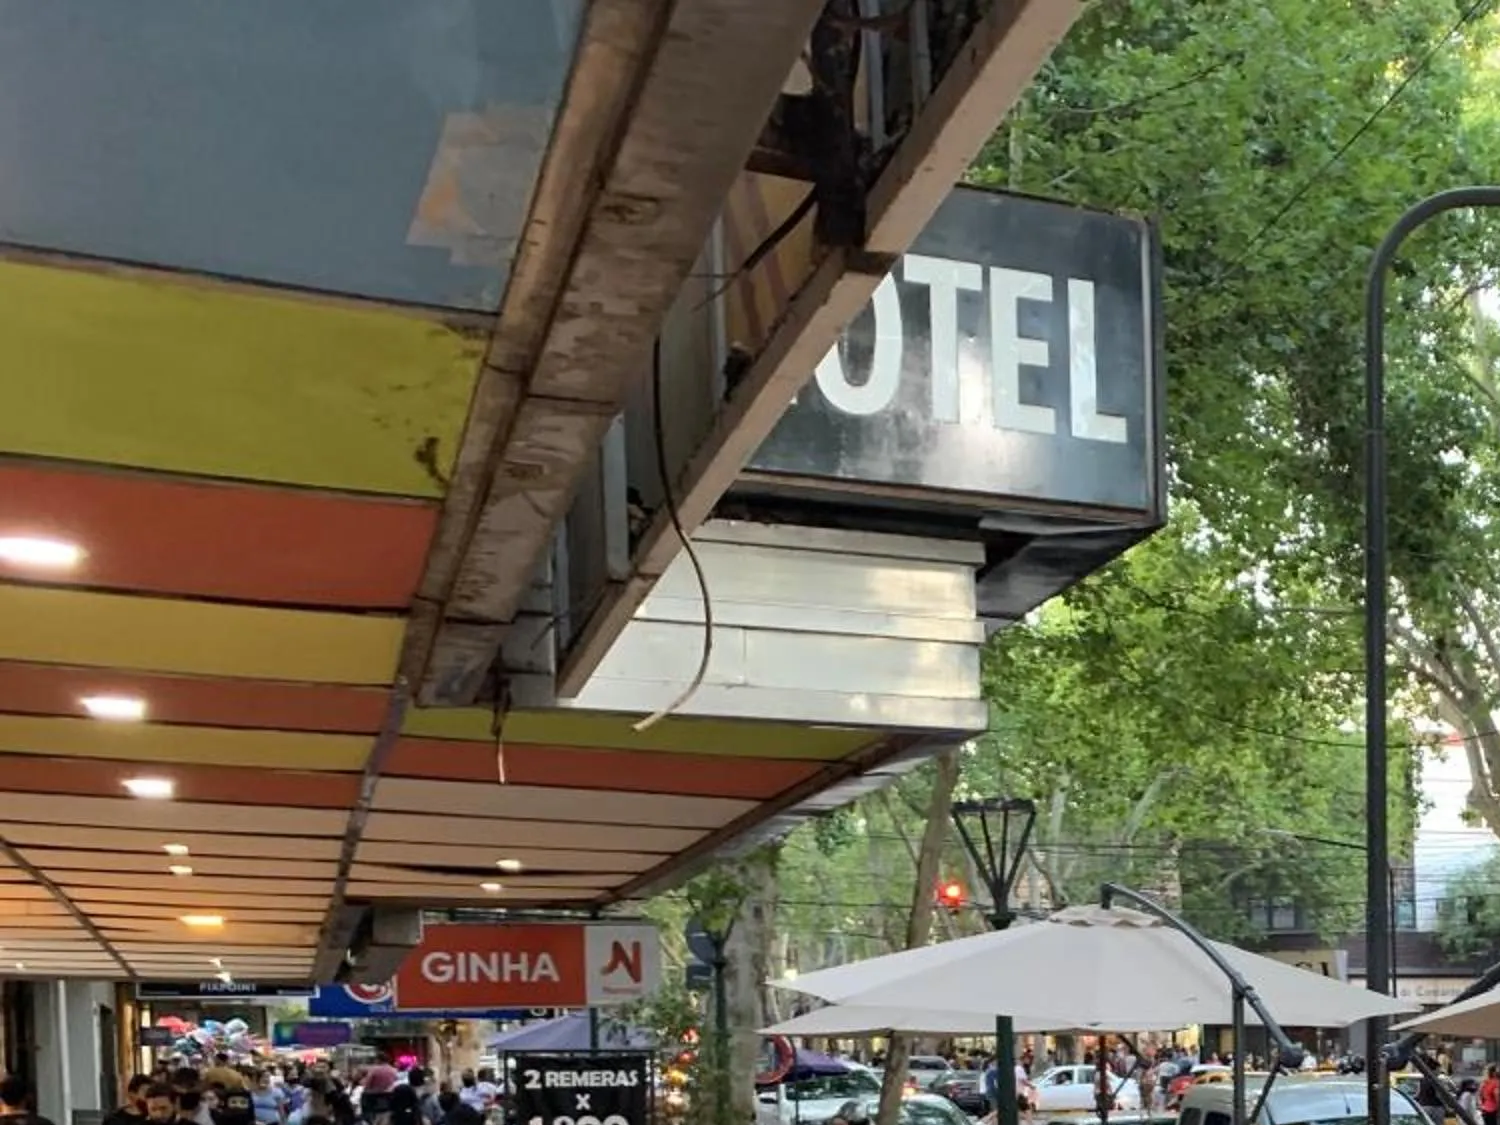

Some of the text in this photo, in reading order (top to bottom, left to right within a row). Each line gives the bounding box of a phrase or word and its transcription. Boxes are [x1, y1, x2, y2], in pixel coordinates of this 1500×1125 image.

[790, 254, 1127, 444] OTEL
[420, 951, 561, 983] GINHA
[524, 1069, 639, 1089] 2 REMERAS
